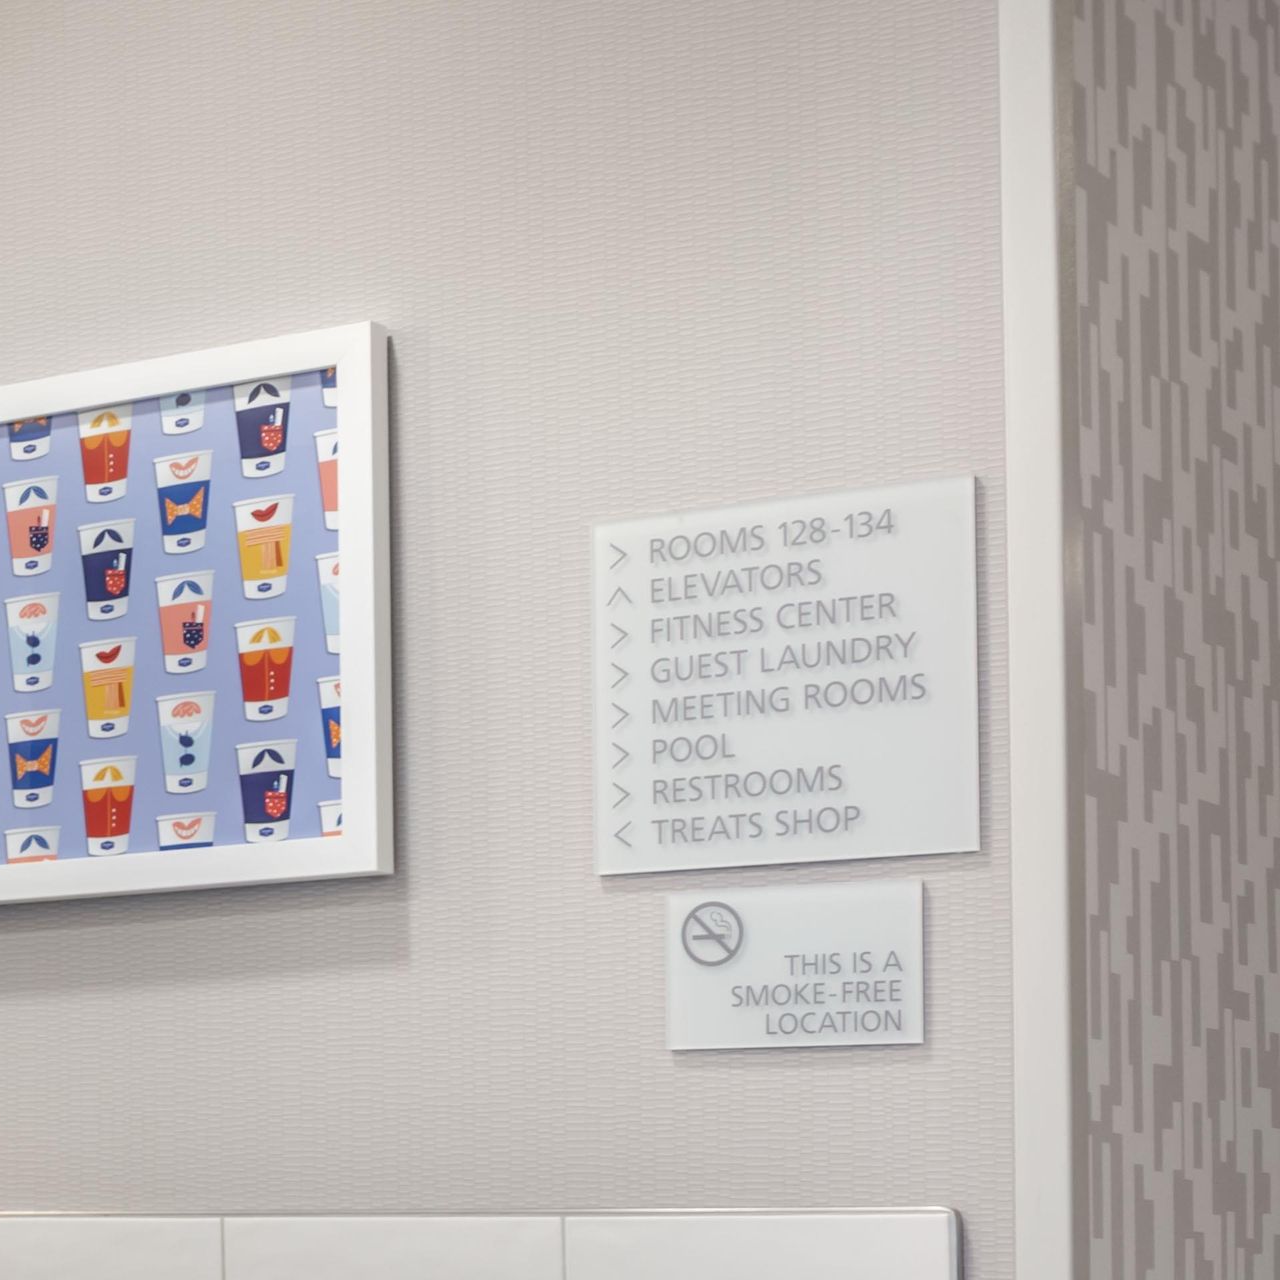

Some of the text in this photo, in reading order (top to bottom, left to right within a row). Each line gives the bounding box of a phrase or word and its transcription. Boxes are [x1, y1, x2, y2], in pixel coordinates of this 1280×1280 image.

[649, 508, 894, 564] ROOMS 128-134
[650, 559, 823, 603] ELEVATORS
[651, 592, 897, 644] FITNESS CENTER
[650, 631, 917, 684] GUEST LAUNDRY
[652, 673, 927, 725] MEETING ROOMS
[652, 733, 736, 764] POOL
[652, 764, 843, 804] RESTROOMS
[651, 805, 861, 845] TREATS SHOP
[784, 950, 903, 976] THIS IS A
[731, 980, 903, 1008] SMOKE-FREE
[765, 1009, 903, 1035] LOCATION
